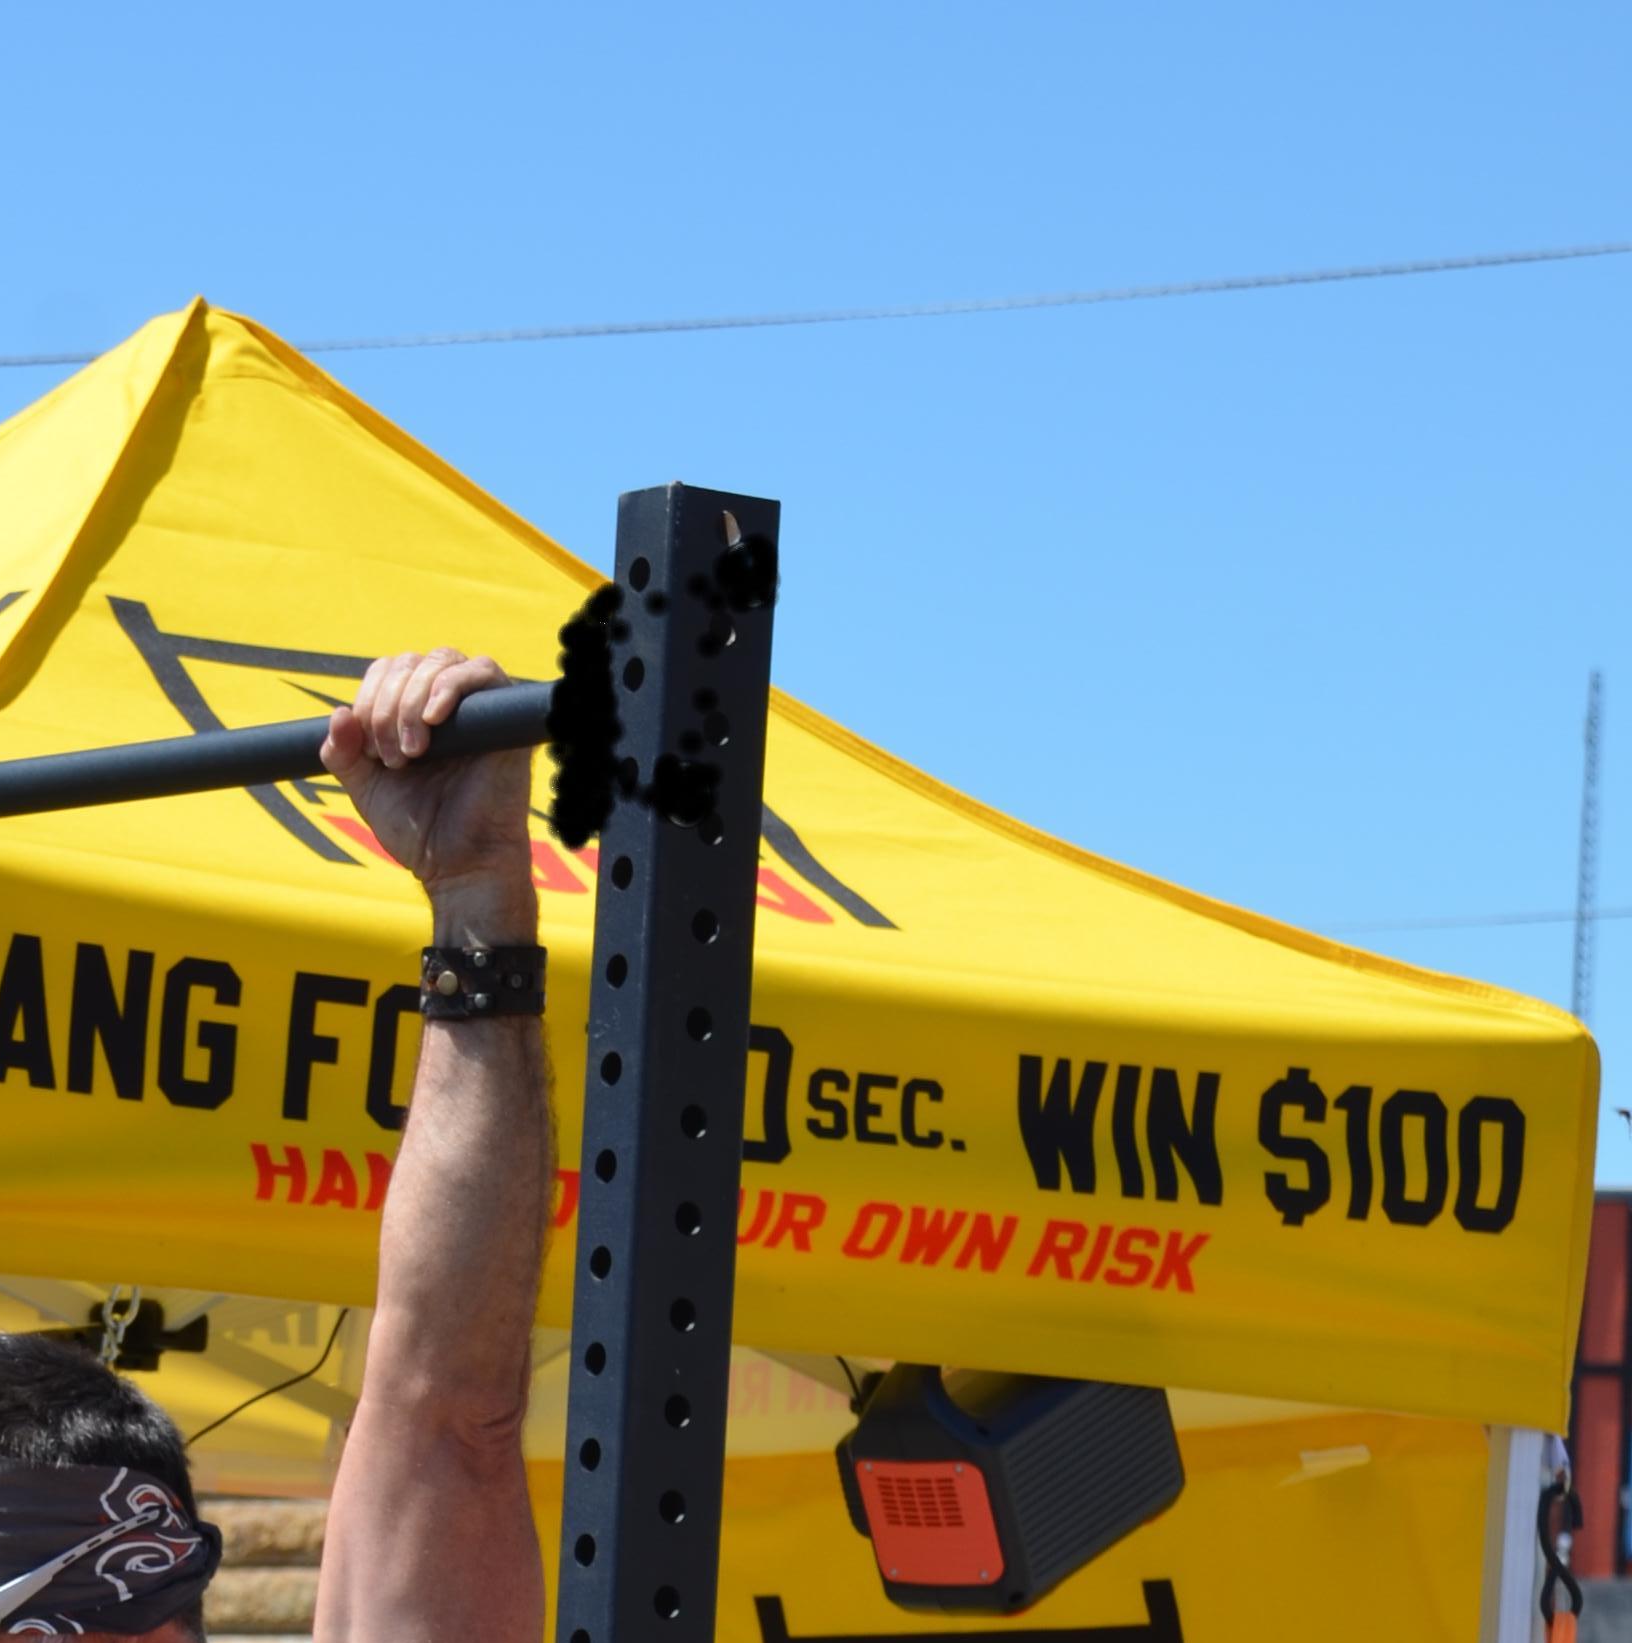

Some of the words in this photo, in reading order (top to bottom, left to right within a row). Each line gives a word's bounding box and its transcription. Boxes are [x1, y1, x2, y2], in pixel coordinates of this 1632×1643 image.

[281, 971, 422, 1131] FO
[805, 1066, 968, 1154] SEC.
[1017, 1053, 1225, 1208] WIN
[1257, 1066, 1527, 1235] $100
[841, 1200, 1019, 1274] OWN
[1026, 1217, 1212, 1294] RISK
